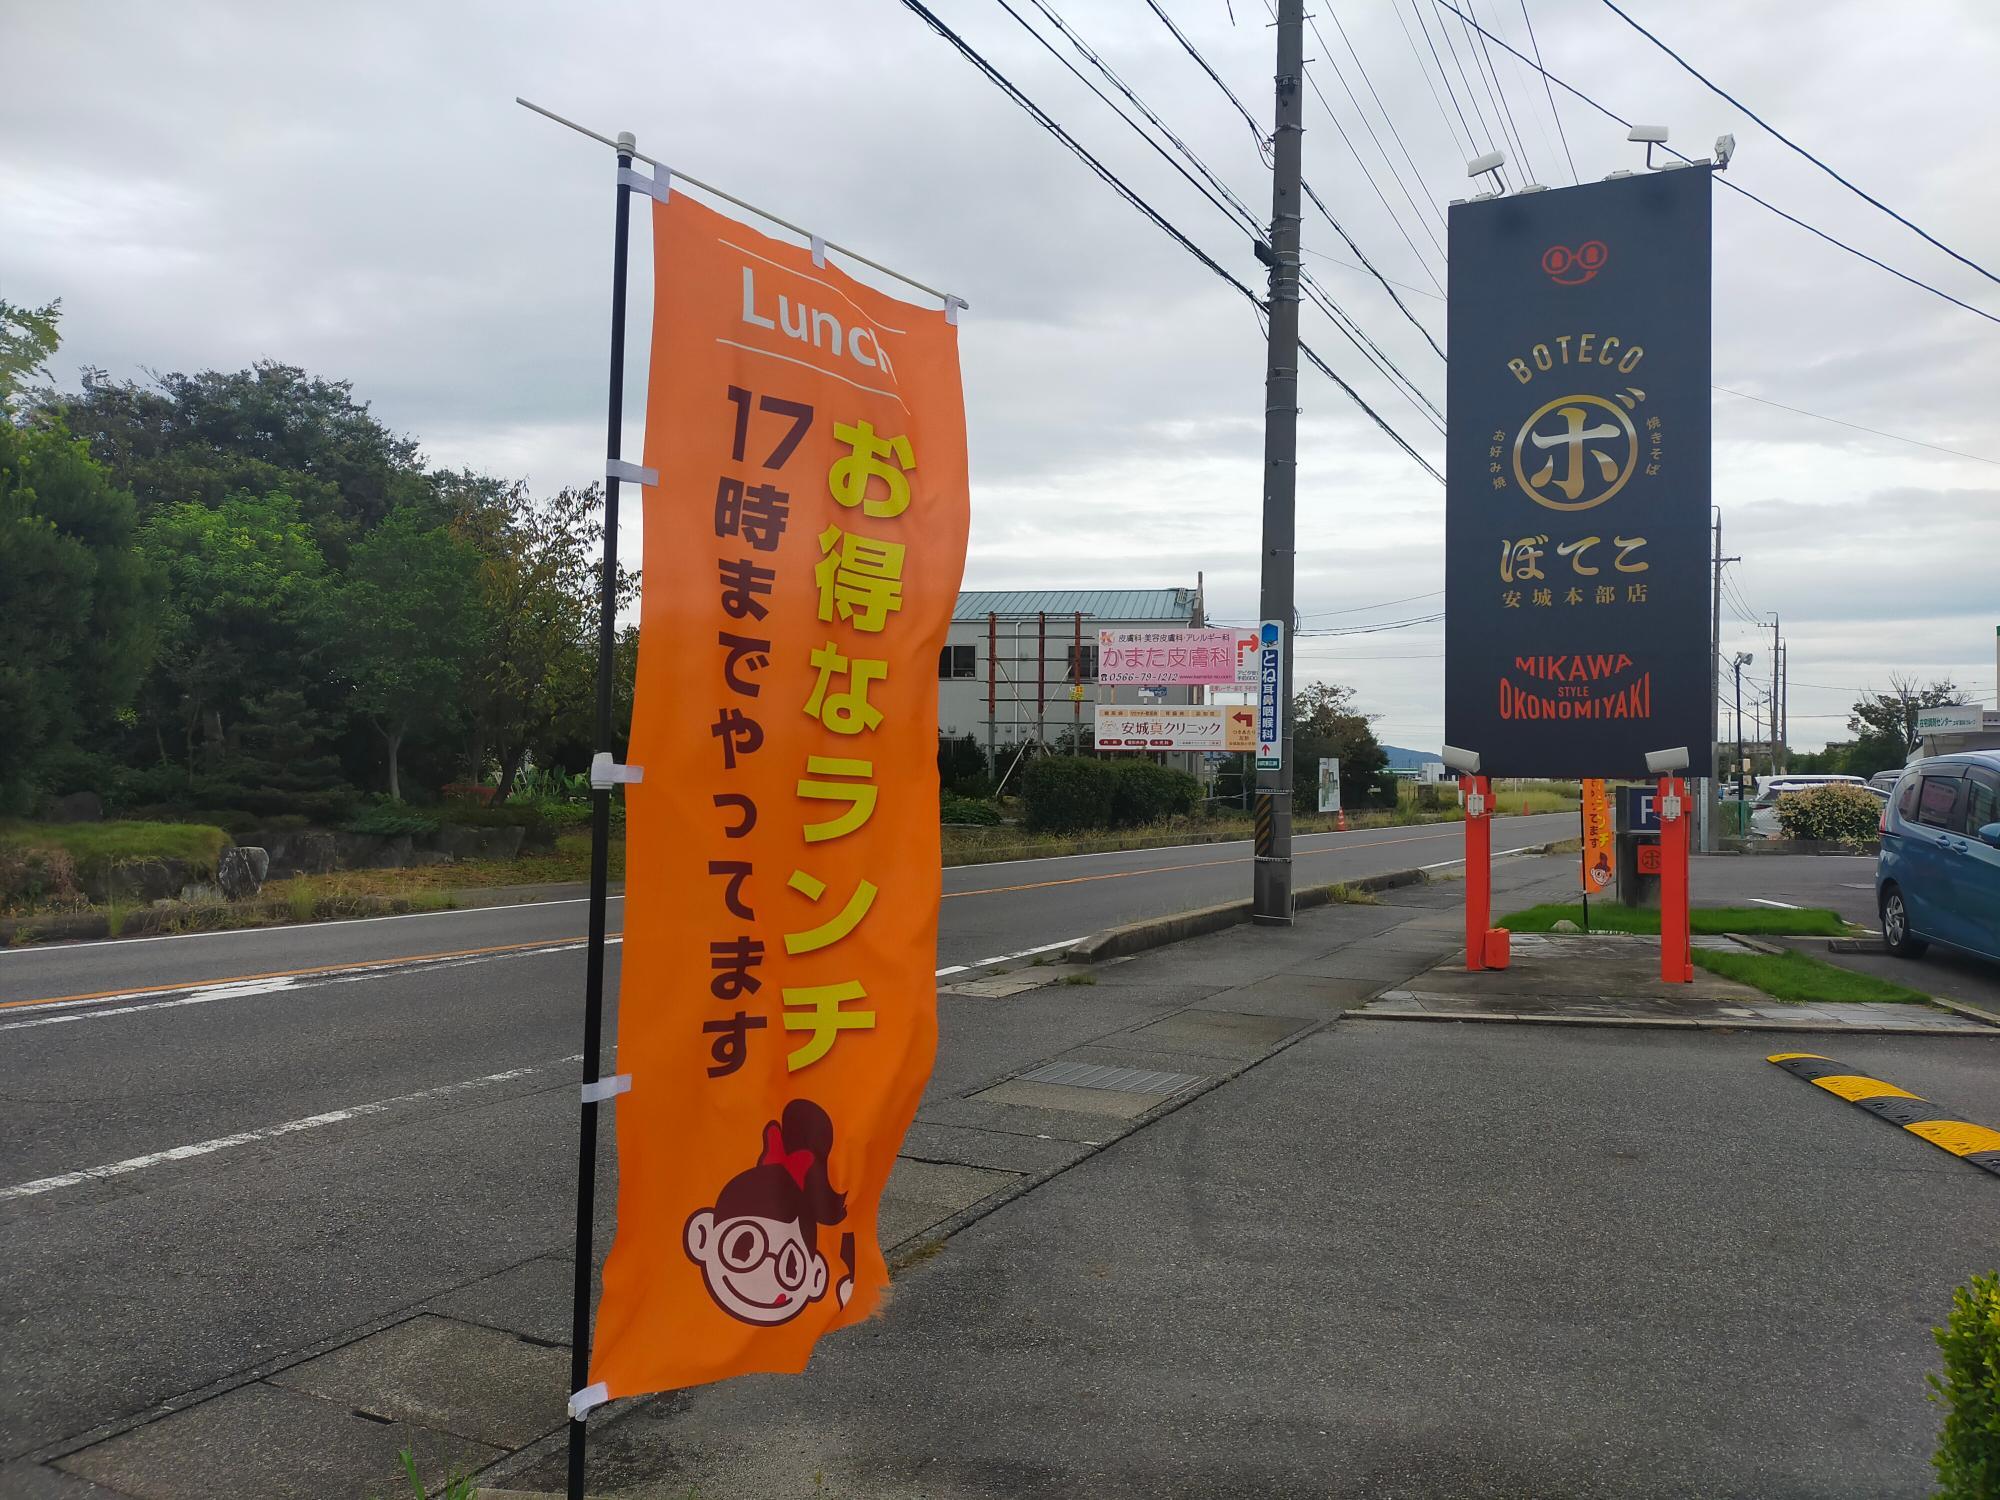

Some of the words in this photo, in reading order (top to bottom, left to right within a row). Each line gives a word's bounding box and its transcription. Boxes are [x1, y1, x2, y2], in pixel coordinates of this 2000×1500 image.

[741, 266, 898, 386] Lunch
[1507, 333, 1644, 384] BOTECO
[1489, 430, 1507, 489] お好み焼
[1646, 416, 1664, 477] 焼きそば
[1500, 534, 1650, 583] ぼてこ
[1502, 583, 1649, 609] 安城本部店
[1102, 647, 1231, 668] かまた皮膚科
[1109, 673, 1179, 682] 0566-79-1212
[1515, 653, 1633, 683] MIKAWA
[1261, 652, 1277, 740] とね耳鼻咽喉科
[1499, 671, 1651, 721] OKONOMIYAKI
[1558, 687, 1590, 697] STYLE
[702, 384, 815, 1079] 17時までやってます
[782, 419, 917, 1073] お得なランチ
[1121, 721, 1222, 736] 安城真クリニック
